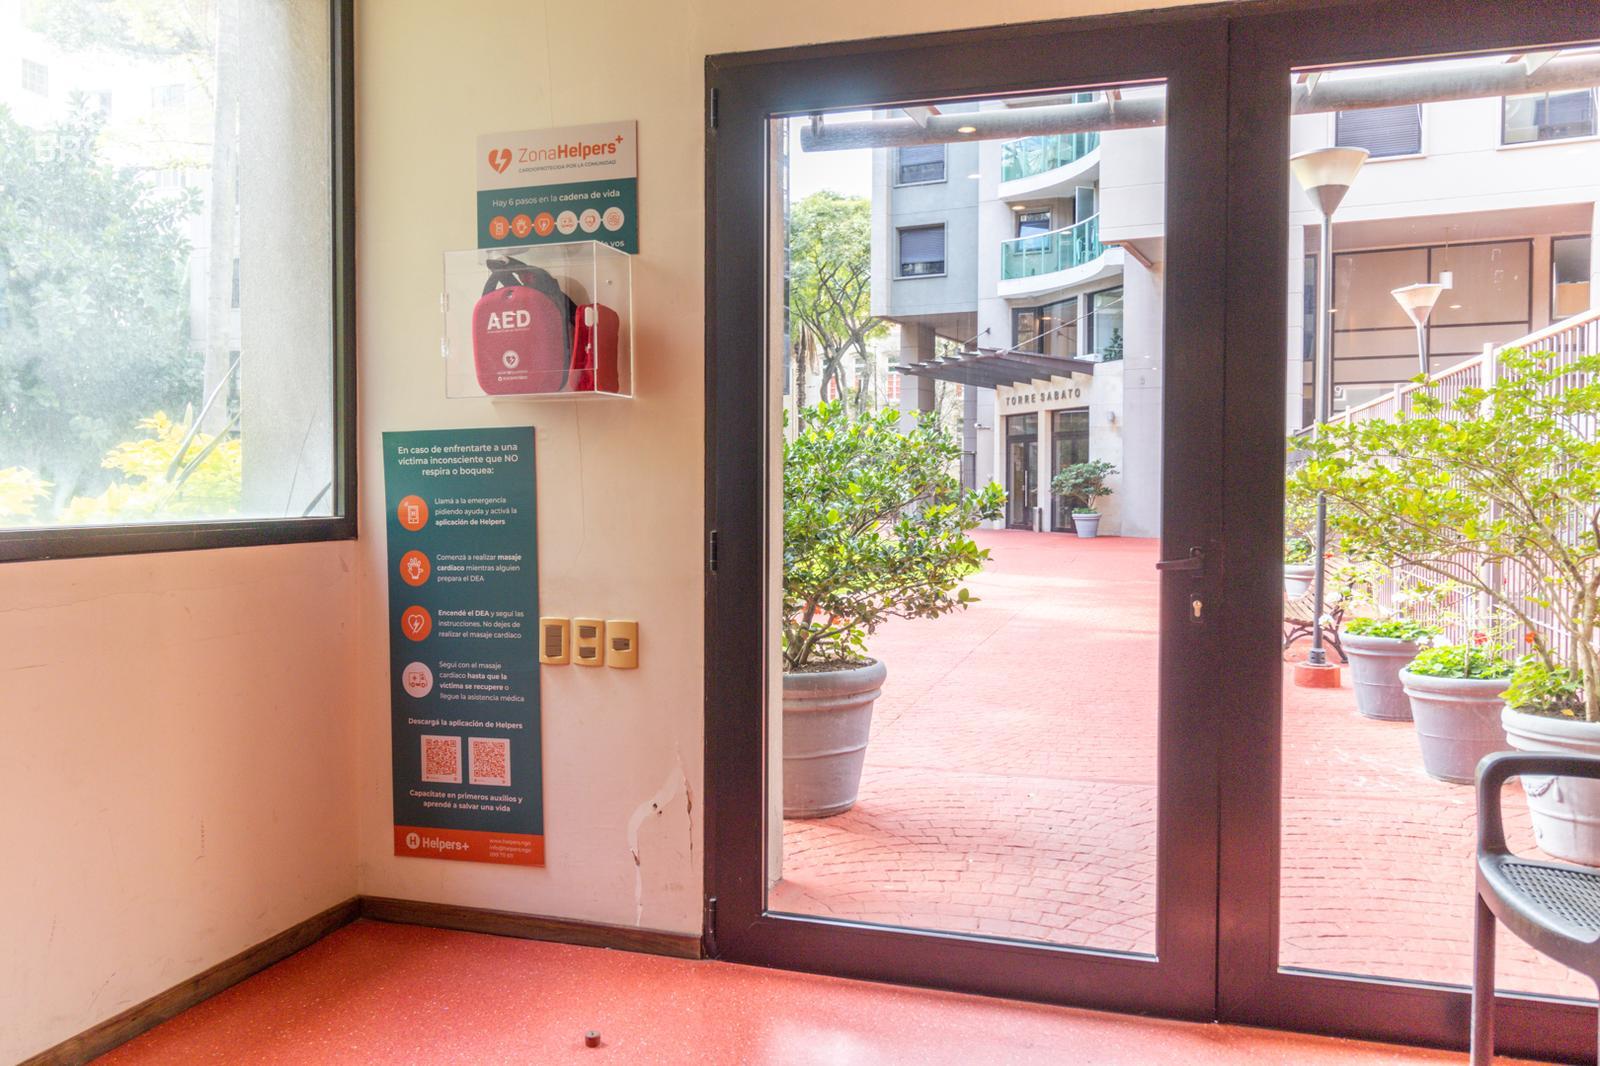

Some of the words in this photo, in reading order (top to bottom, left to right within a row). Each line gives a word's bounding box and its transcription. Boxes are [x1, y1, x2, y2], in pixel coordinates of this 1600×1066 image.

[492, 200, 507, 208] Hay
[508, 198, 513, 206] 6
[515, 197, 538, 207] pasos
[550, 194, 558, 202] la
[559, 192, 588, 201] cadena
[590, 191, 600, 199] de
[602, 190, 620, 198] vida
[488, 310, 531, 330] AED
[1006, 394, 1036, 406] TORRE
[1040, 388, 1080, 402] SABATO
[444, 445, 490, 453] enfrentarte
[398, 456, 428, 465] víctima
[430, 456, 483, 464] inconsciente
[486, 456, 502, 464] que
[422, 467, 450, 476] respira
[460, 466, 494, 476] boquea:
[468, 497, 506, 506] emergencia
[435, 507, 463, 516] pidiendo
[464, 508, 484, 516] ayuda
[436, 518, 468, 526] aplicación
[480, 518, 506, 526] Helpers
[496, 564, 520, 572] alguien
[438, 620, 482, 628] instrucciones.
[493, 621, 510, 629] dejes
[479, 662, 501, 670] masaje
[440, 693, 459, 701] llegue
[449, 720, 484, 728] aplicación
[496, 721, 523, 729] Helpers
[457, 792, 488, 801] primeros
[459, 802, 479, 810] salvar
[495, 804, 511, 812] vida
